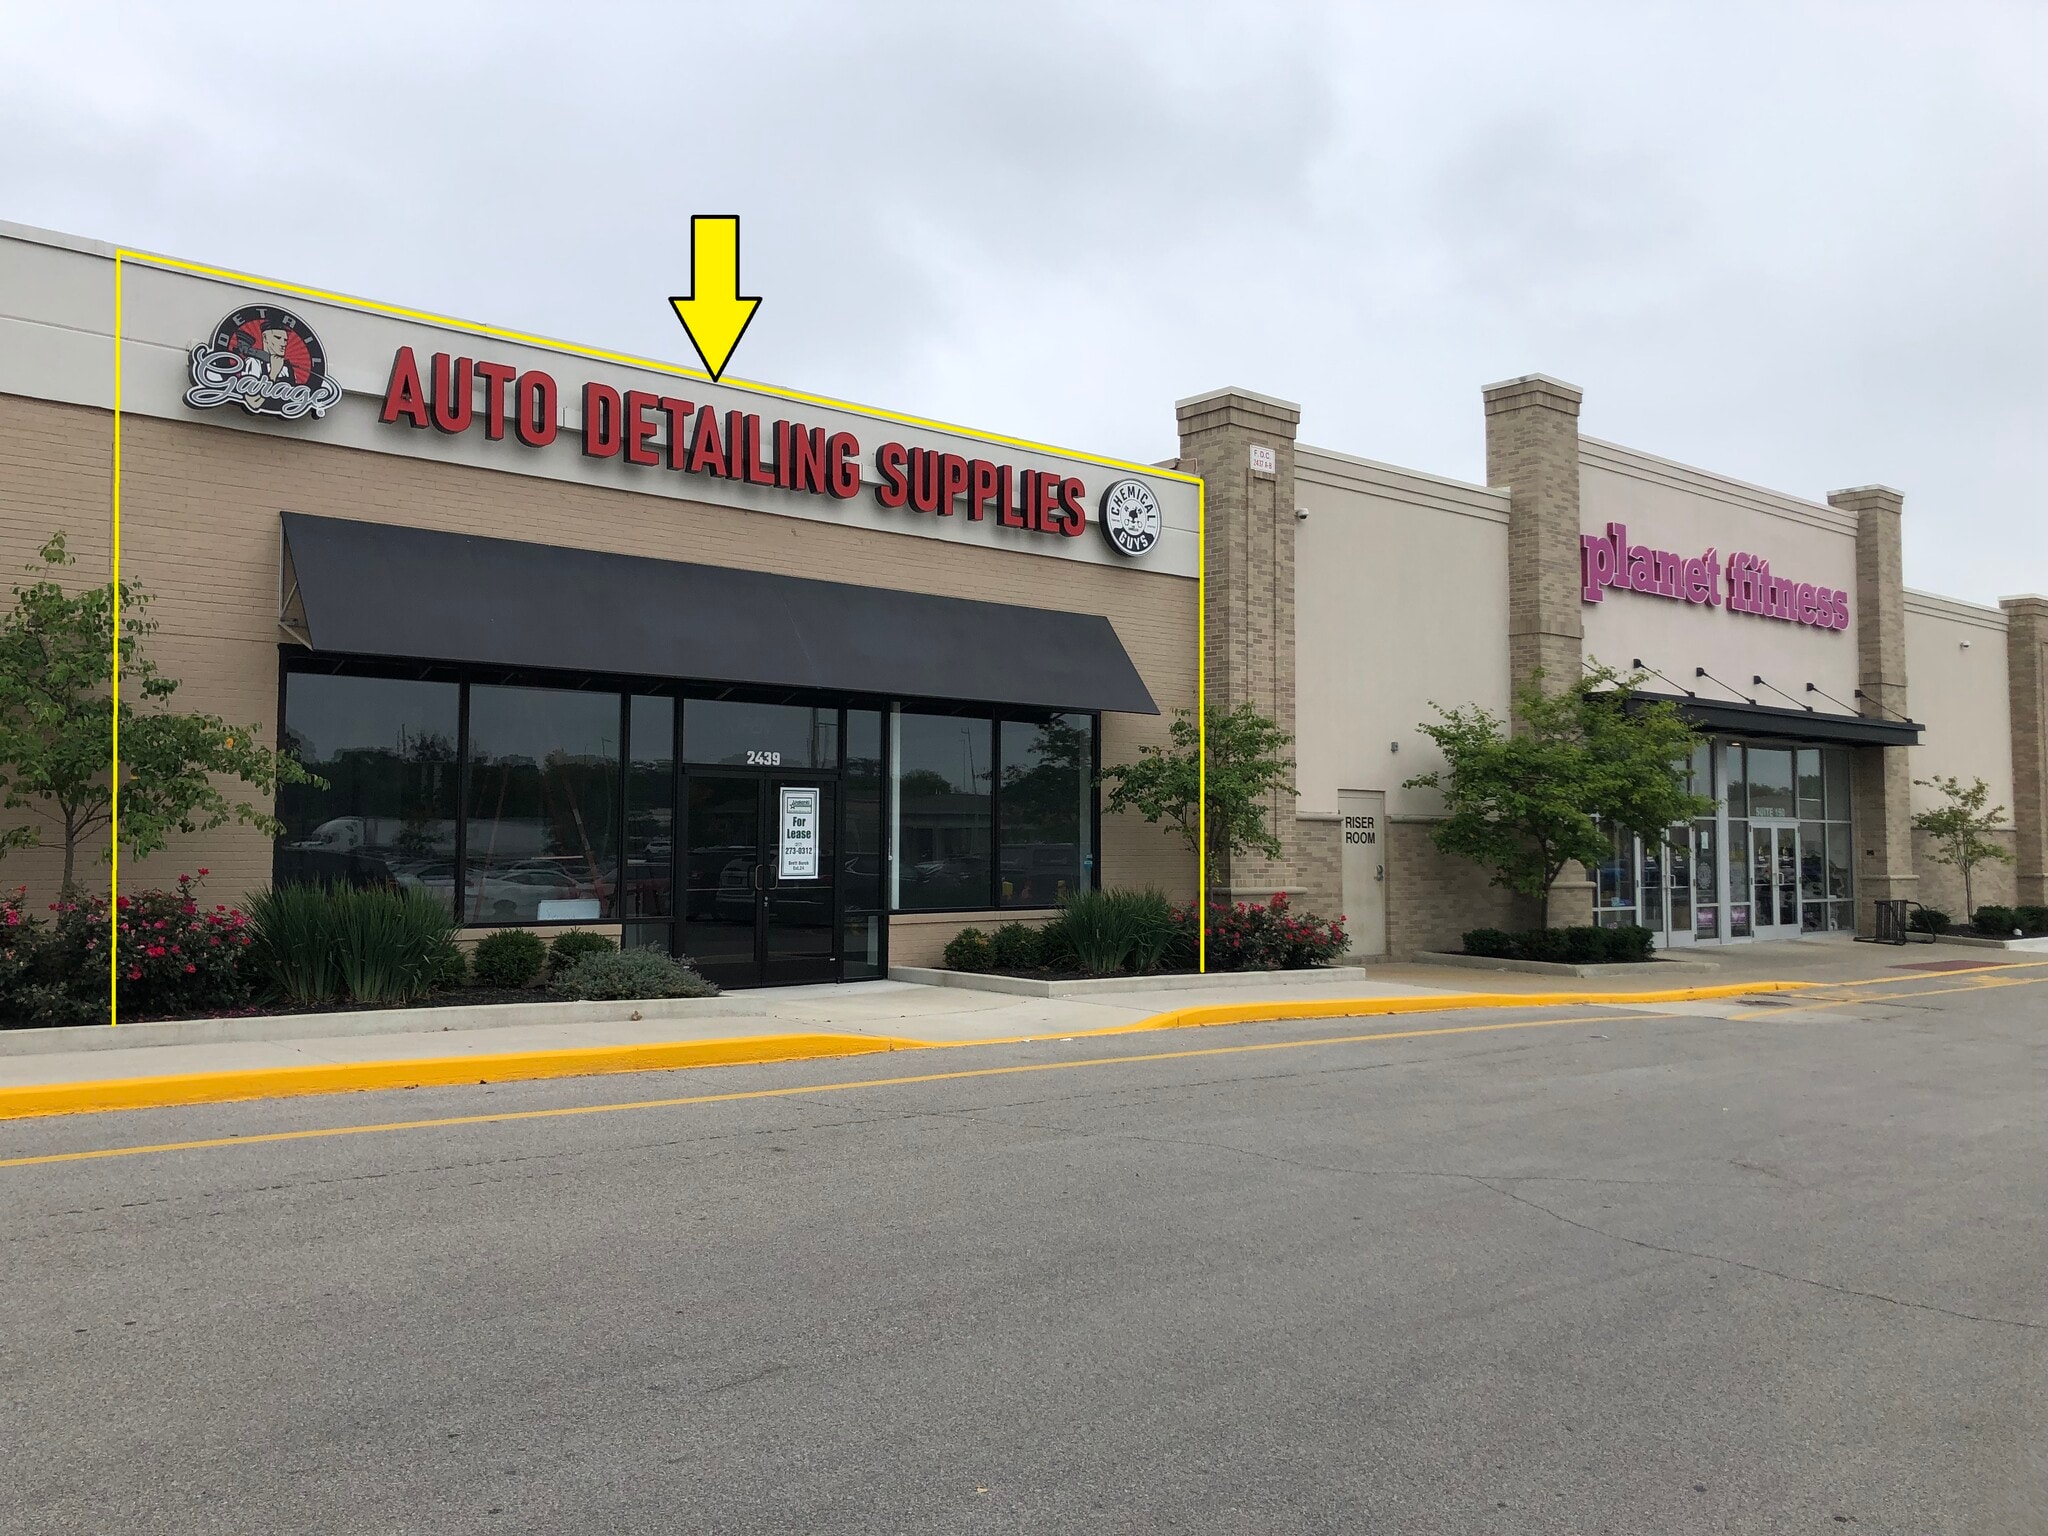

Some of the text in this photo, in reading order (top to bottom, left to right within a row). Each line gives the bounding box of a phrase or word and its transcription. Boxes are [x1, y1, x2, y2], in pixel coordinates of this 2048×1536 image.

[217, 308, 322, 368] DETAIL
[189, 350, 338, 416] Garage
[379, 346, 1086, 537] AUTO DETAILING SUPPLIES
[1111, 486, 1156, 521] CHEMICAL
[1119, 531, 1148, 550] GUYS
[1580, 522, 1850, 631] planet fitness
[746, 750, 780, 766] 2439
[1755, 806, 1774, 817] SUITE
[792, 816, 806, 827] For
[1345, 816, 1374, 829] RISER
[787, 828, 812, 839] Lease
[1345, 831, 1376, 844] ROOM
[785, 847, 813, 855] 273-0312
